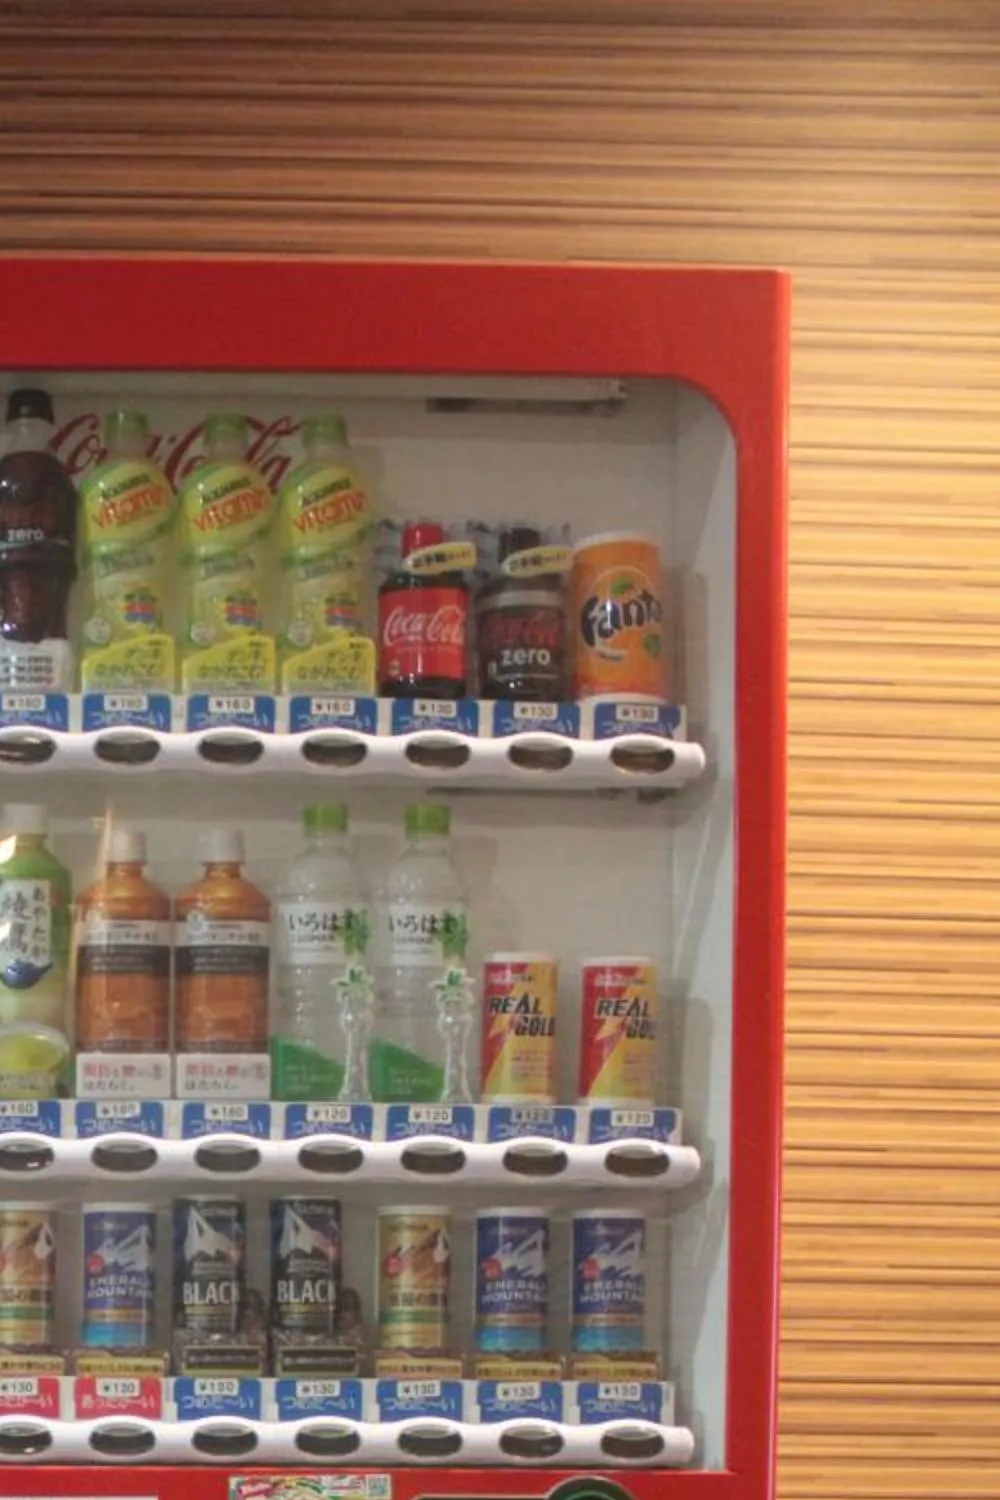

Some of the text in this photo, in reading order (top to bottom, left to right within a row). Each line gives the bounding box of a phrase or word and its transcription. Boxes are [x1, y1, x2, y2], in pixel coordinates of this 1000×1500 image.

[7, 527, 44, 542] zero
[500, 648, 551, 667] zero
[489, 994, 542, 1015] REAL
[597, 997, 652, 1017] REAL
